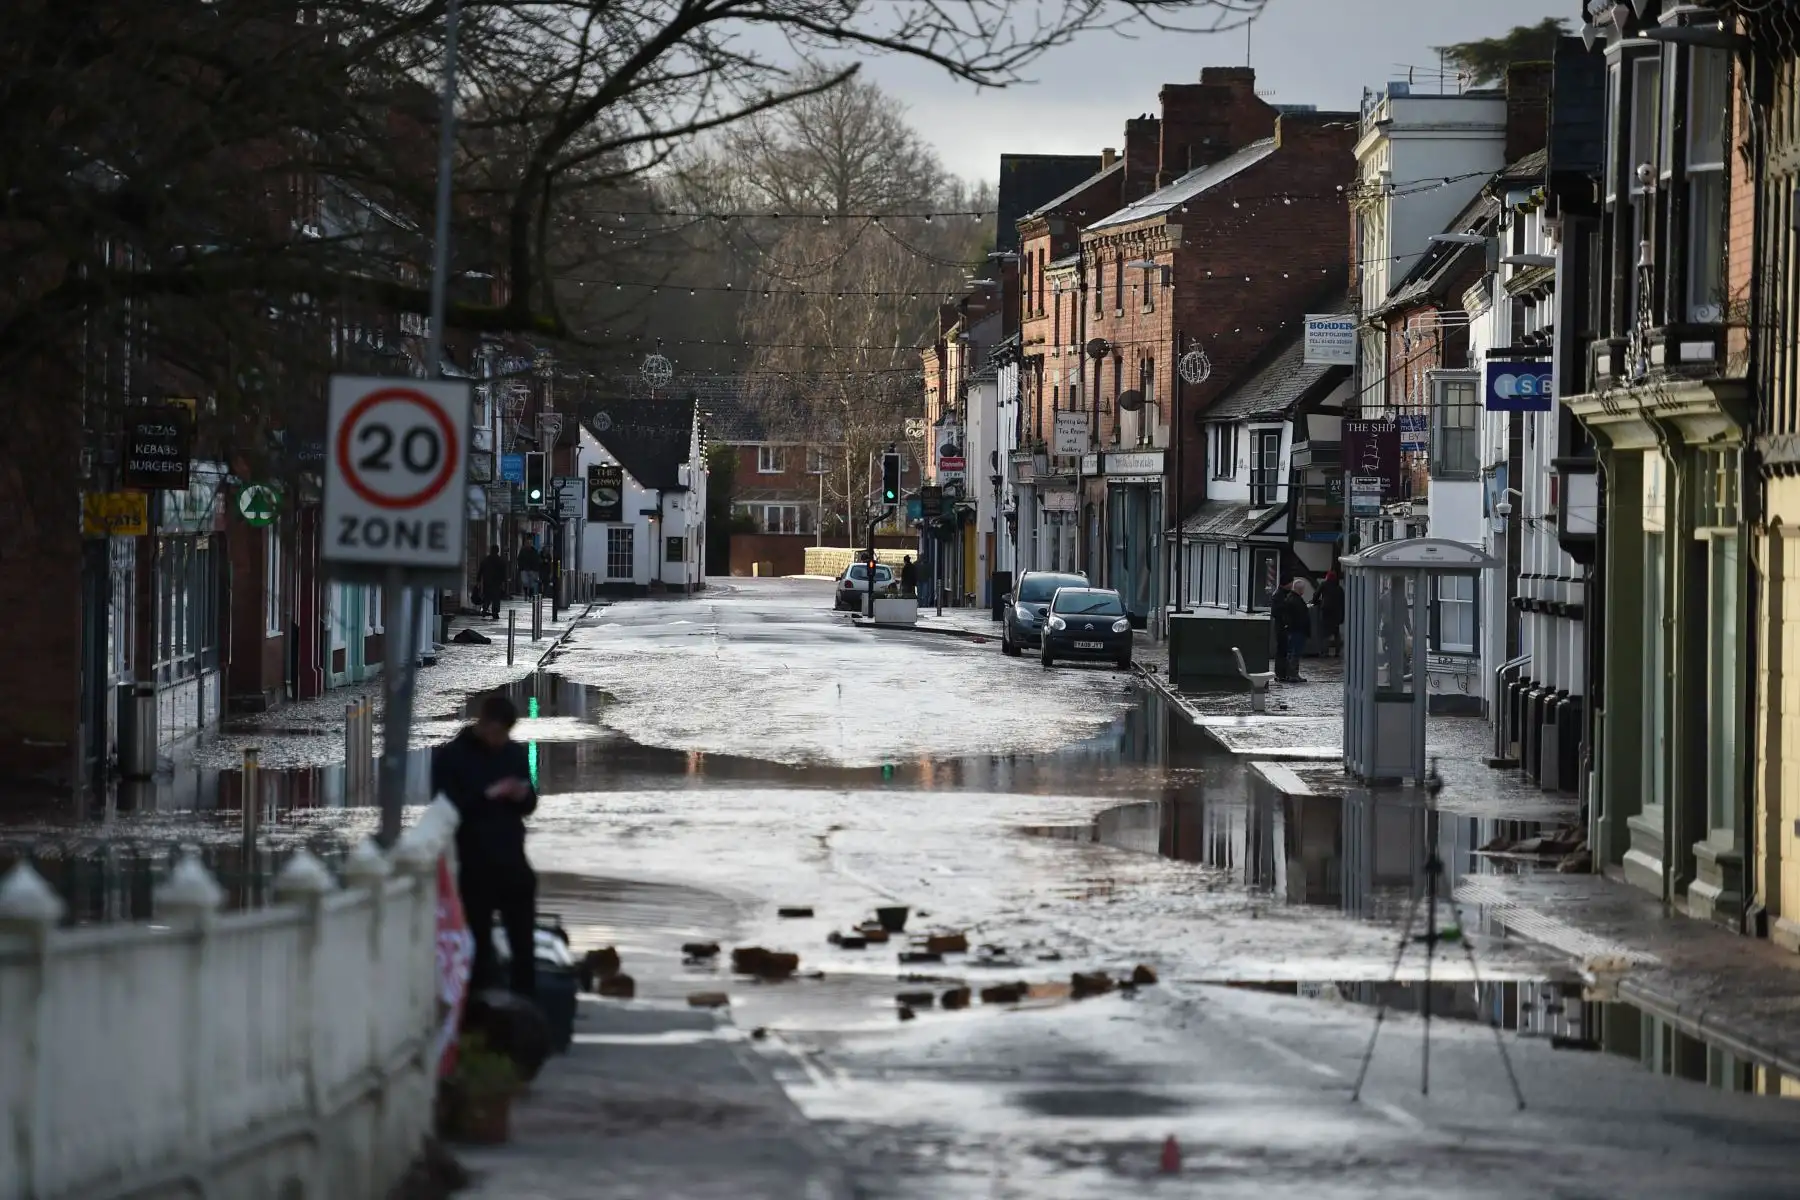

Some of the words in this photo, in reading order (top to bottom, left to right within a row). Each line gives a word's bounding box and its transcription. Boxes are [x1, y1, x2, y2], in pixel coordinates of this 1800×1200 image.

[1309, 322, 1353, 330] BORDER
[1503, 379, 1552, 393] TSB
[1347, 423, 1369, 432] THE
[1371, 423, 1396, 432] SHIP
[135, 443, 178, 455] KEBABS
[358, 423, 440, 475] 20
[129, 460, 183, 472] BURGERS
[596, 468, 617, 476] THE
[336, 514, 450, 552] ZONE
